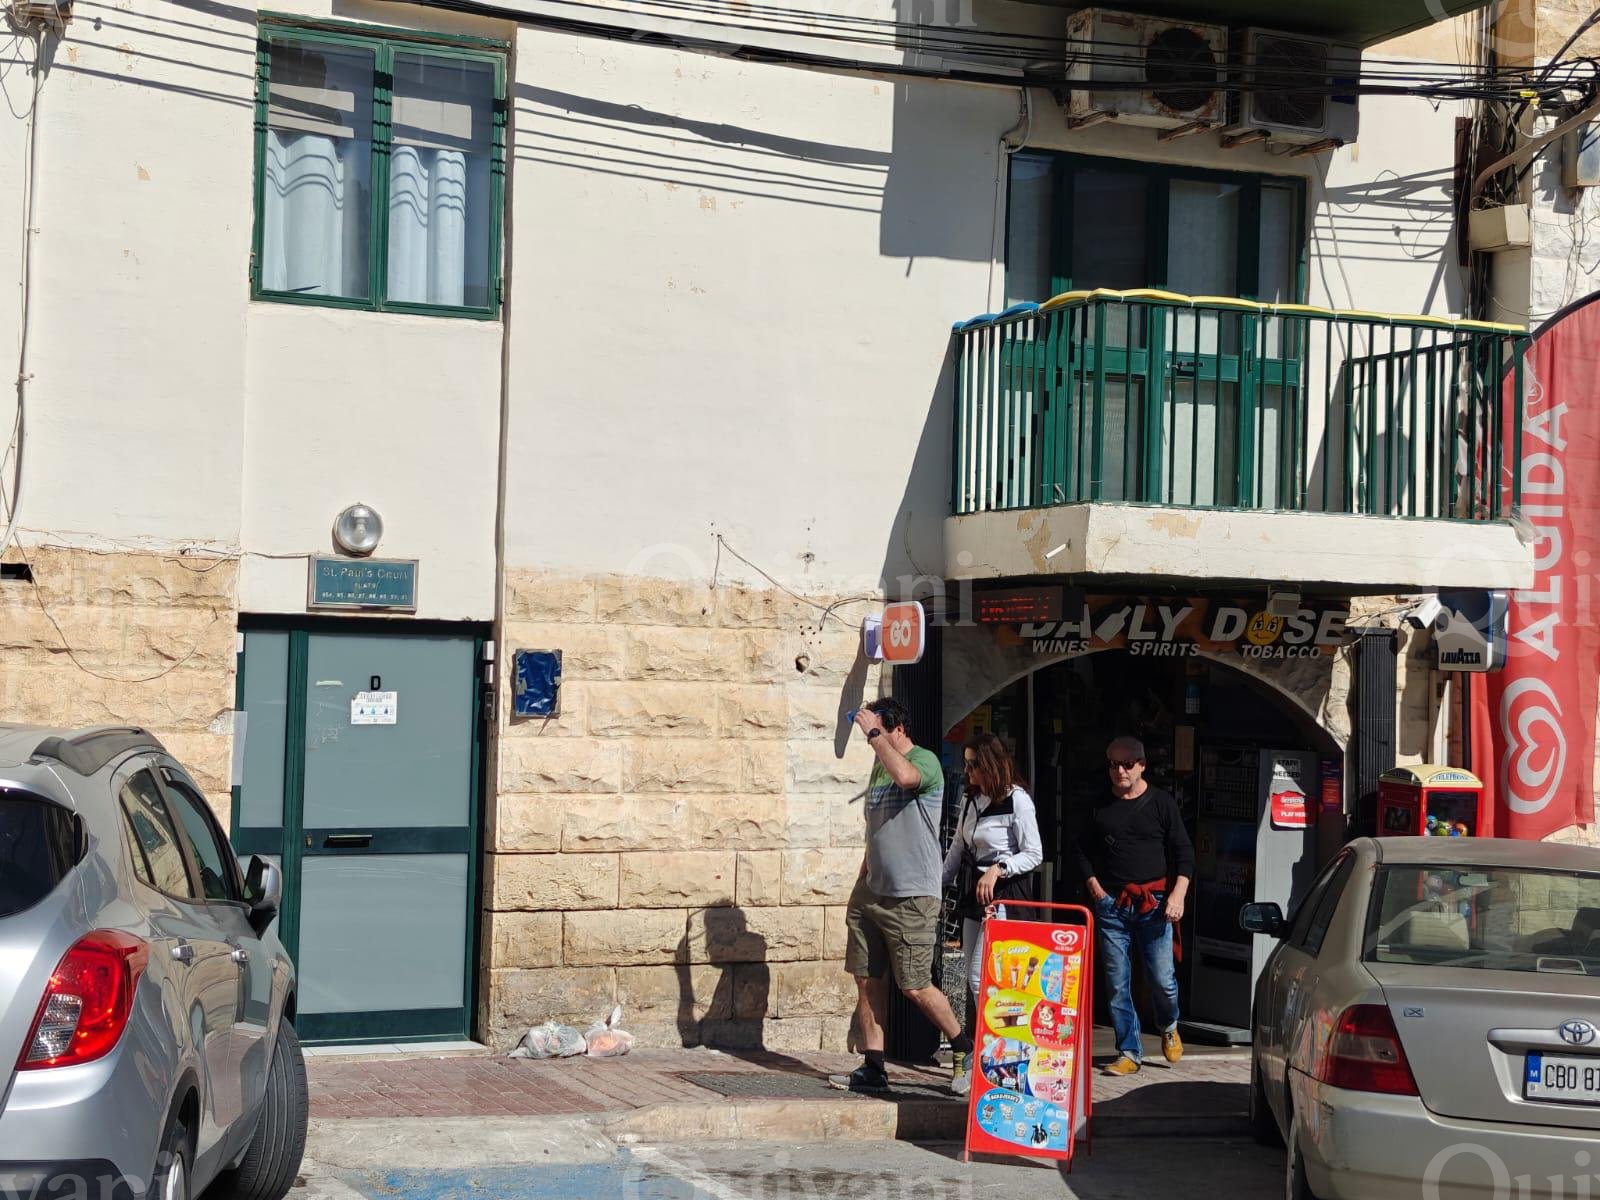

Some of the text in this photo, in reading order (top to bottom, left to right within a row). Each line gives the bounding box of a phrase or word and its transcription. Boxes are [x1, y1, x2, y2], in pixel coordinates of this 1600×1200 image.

[1512, 401, 1569, 663] ALGIDA
[323, 567, 337, 577] St.
[340, 567, 373, 578] Paul's
[890, 619, 912, 648] GO
[1032, 639, 1322, 659] WINES SPIRITS TOBACCO
[370, 675, 381, 691] D
[1530, 1070, 1538, 1078] M
[1545, 1064, 1577, 1089] CBO
